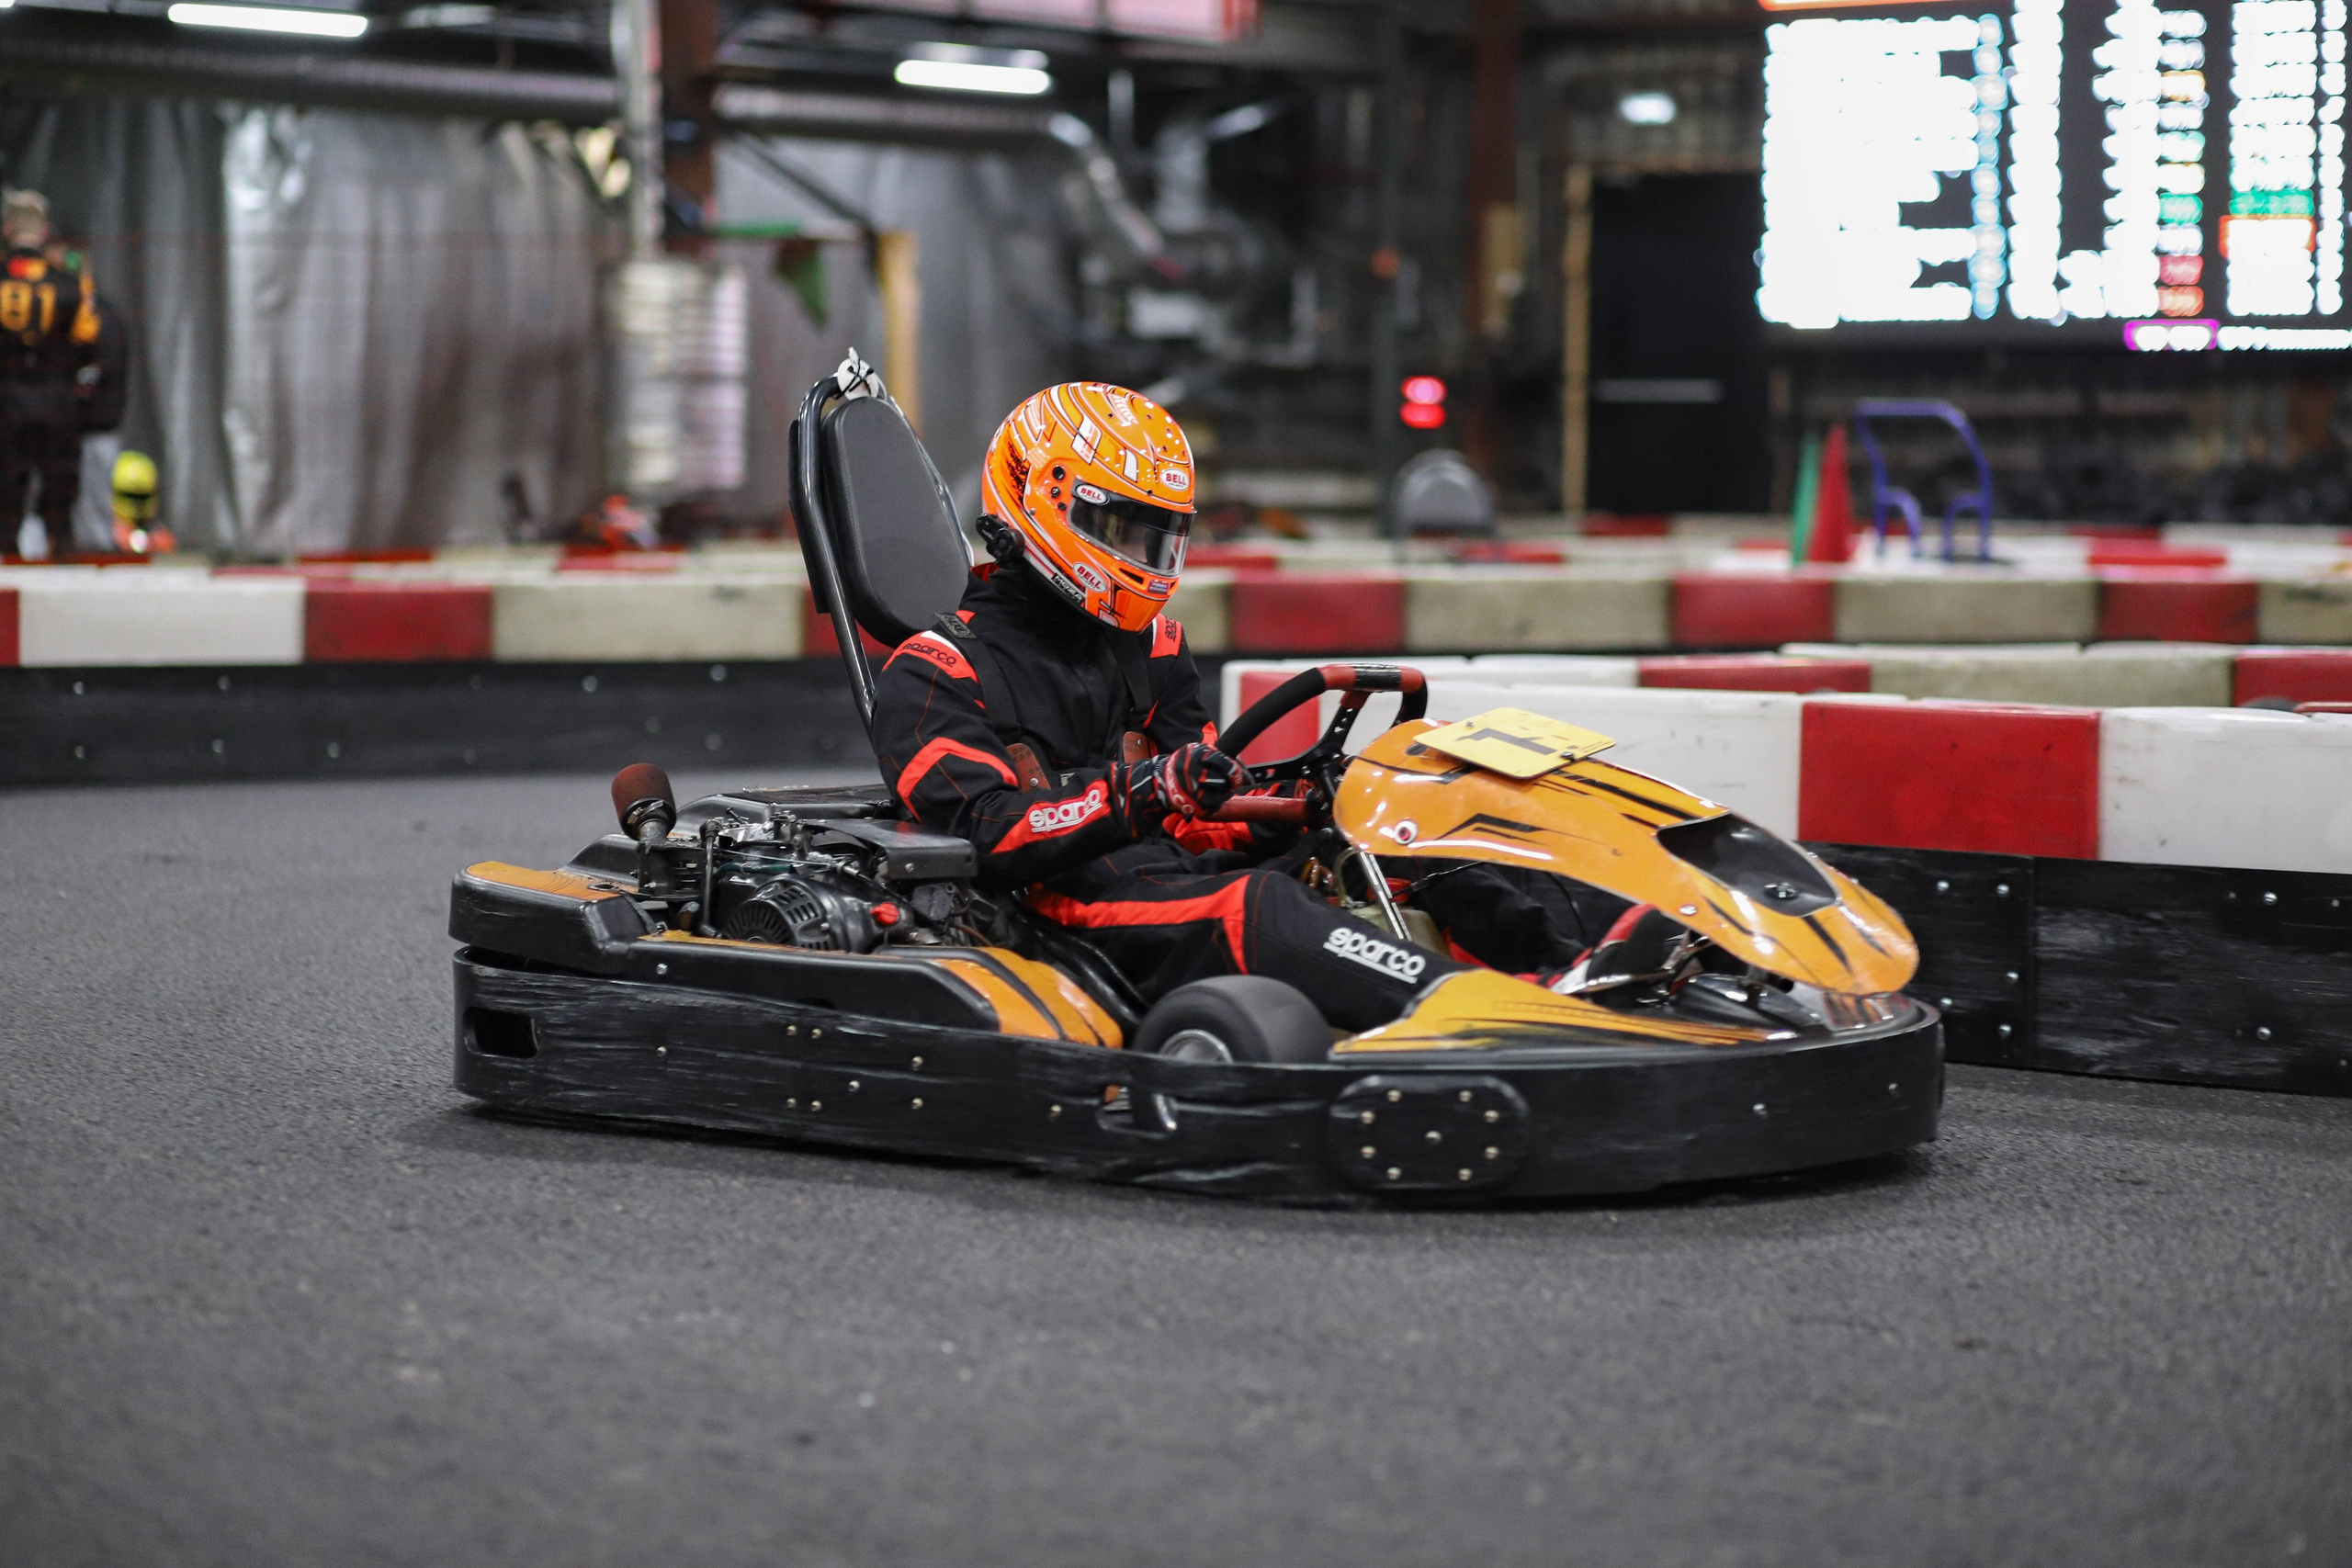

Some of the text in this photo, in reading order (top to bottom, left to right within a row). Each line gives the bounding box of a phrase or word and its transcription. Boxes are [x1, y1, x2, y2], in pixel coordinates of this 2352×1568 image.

[1166, 473, 1186, 485] BELL
[1080, 488, 1102, 501] BELL
[1054, 575, 1083, 600] MOZA
[1077, 566, 1101, 590] BELL
[1029, 790, 1102, 832] sparco
[1325, 928, 1426, 981] sparco
